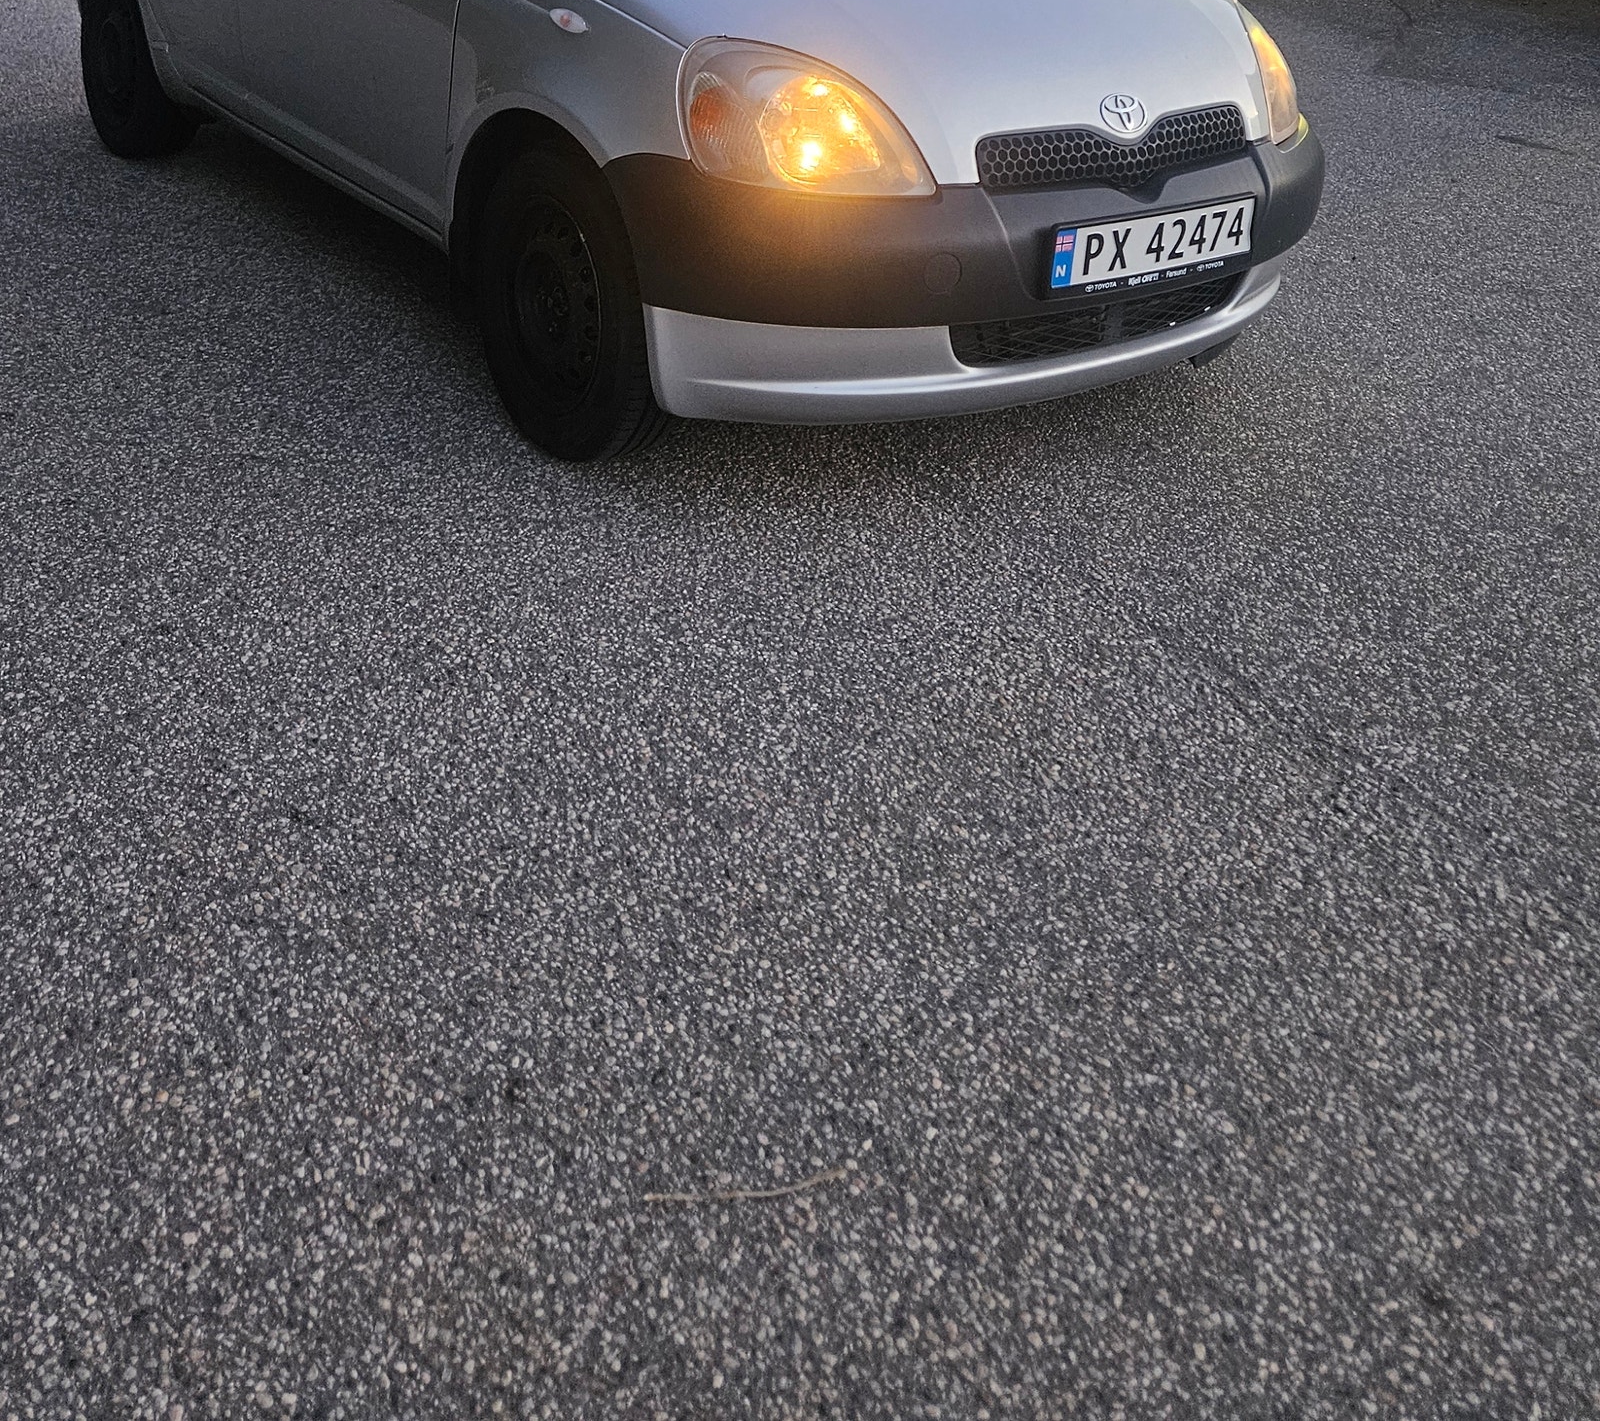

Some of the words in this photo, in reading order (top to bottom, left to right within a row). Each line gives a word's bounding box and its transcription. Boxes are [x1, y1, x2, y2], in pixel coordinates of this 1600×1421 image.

[1082, 227, 1133, 276] PX
[1145, 206, 1246, 263] 42474
[1055, 264, 1067, 278] N
[1094, 281, 1117, 291] TOYOTA
[1165, 267, 1187, 279] Farsund
[1204, 260, 1225, 270] TOYOTA
